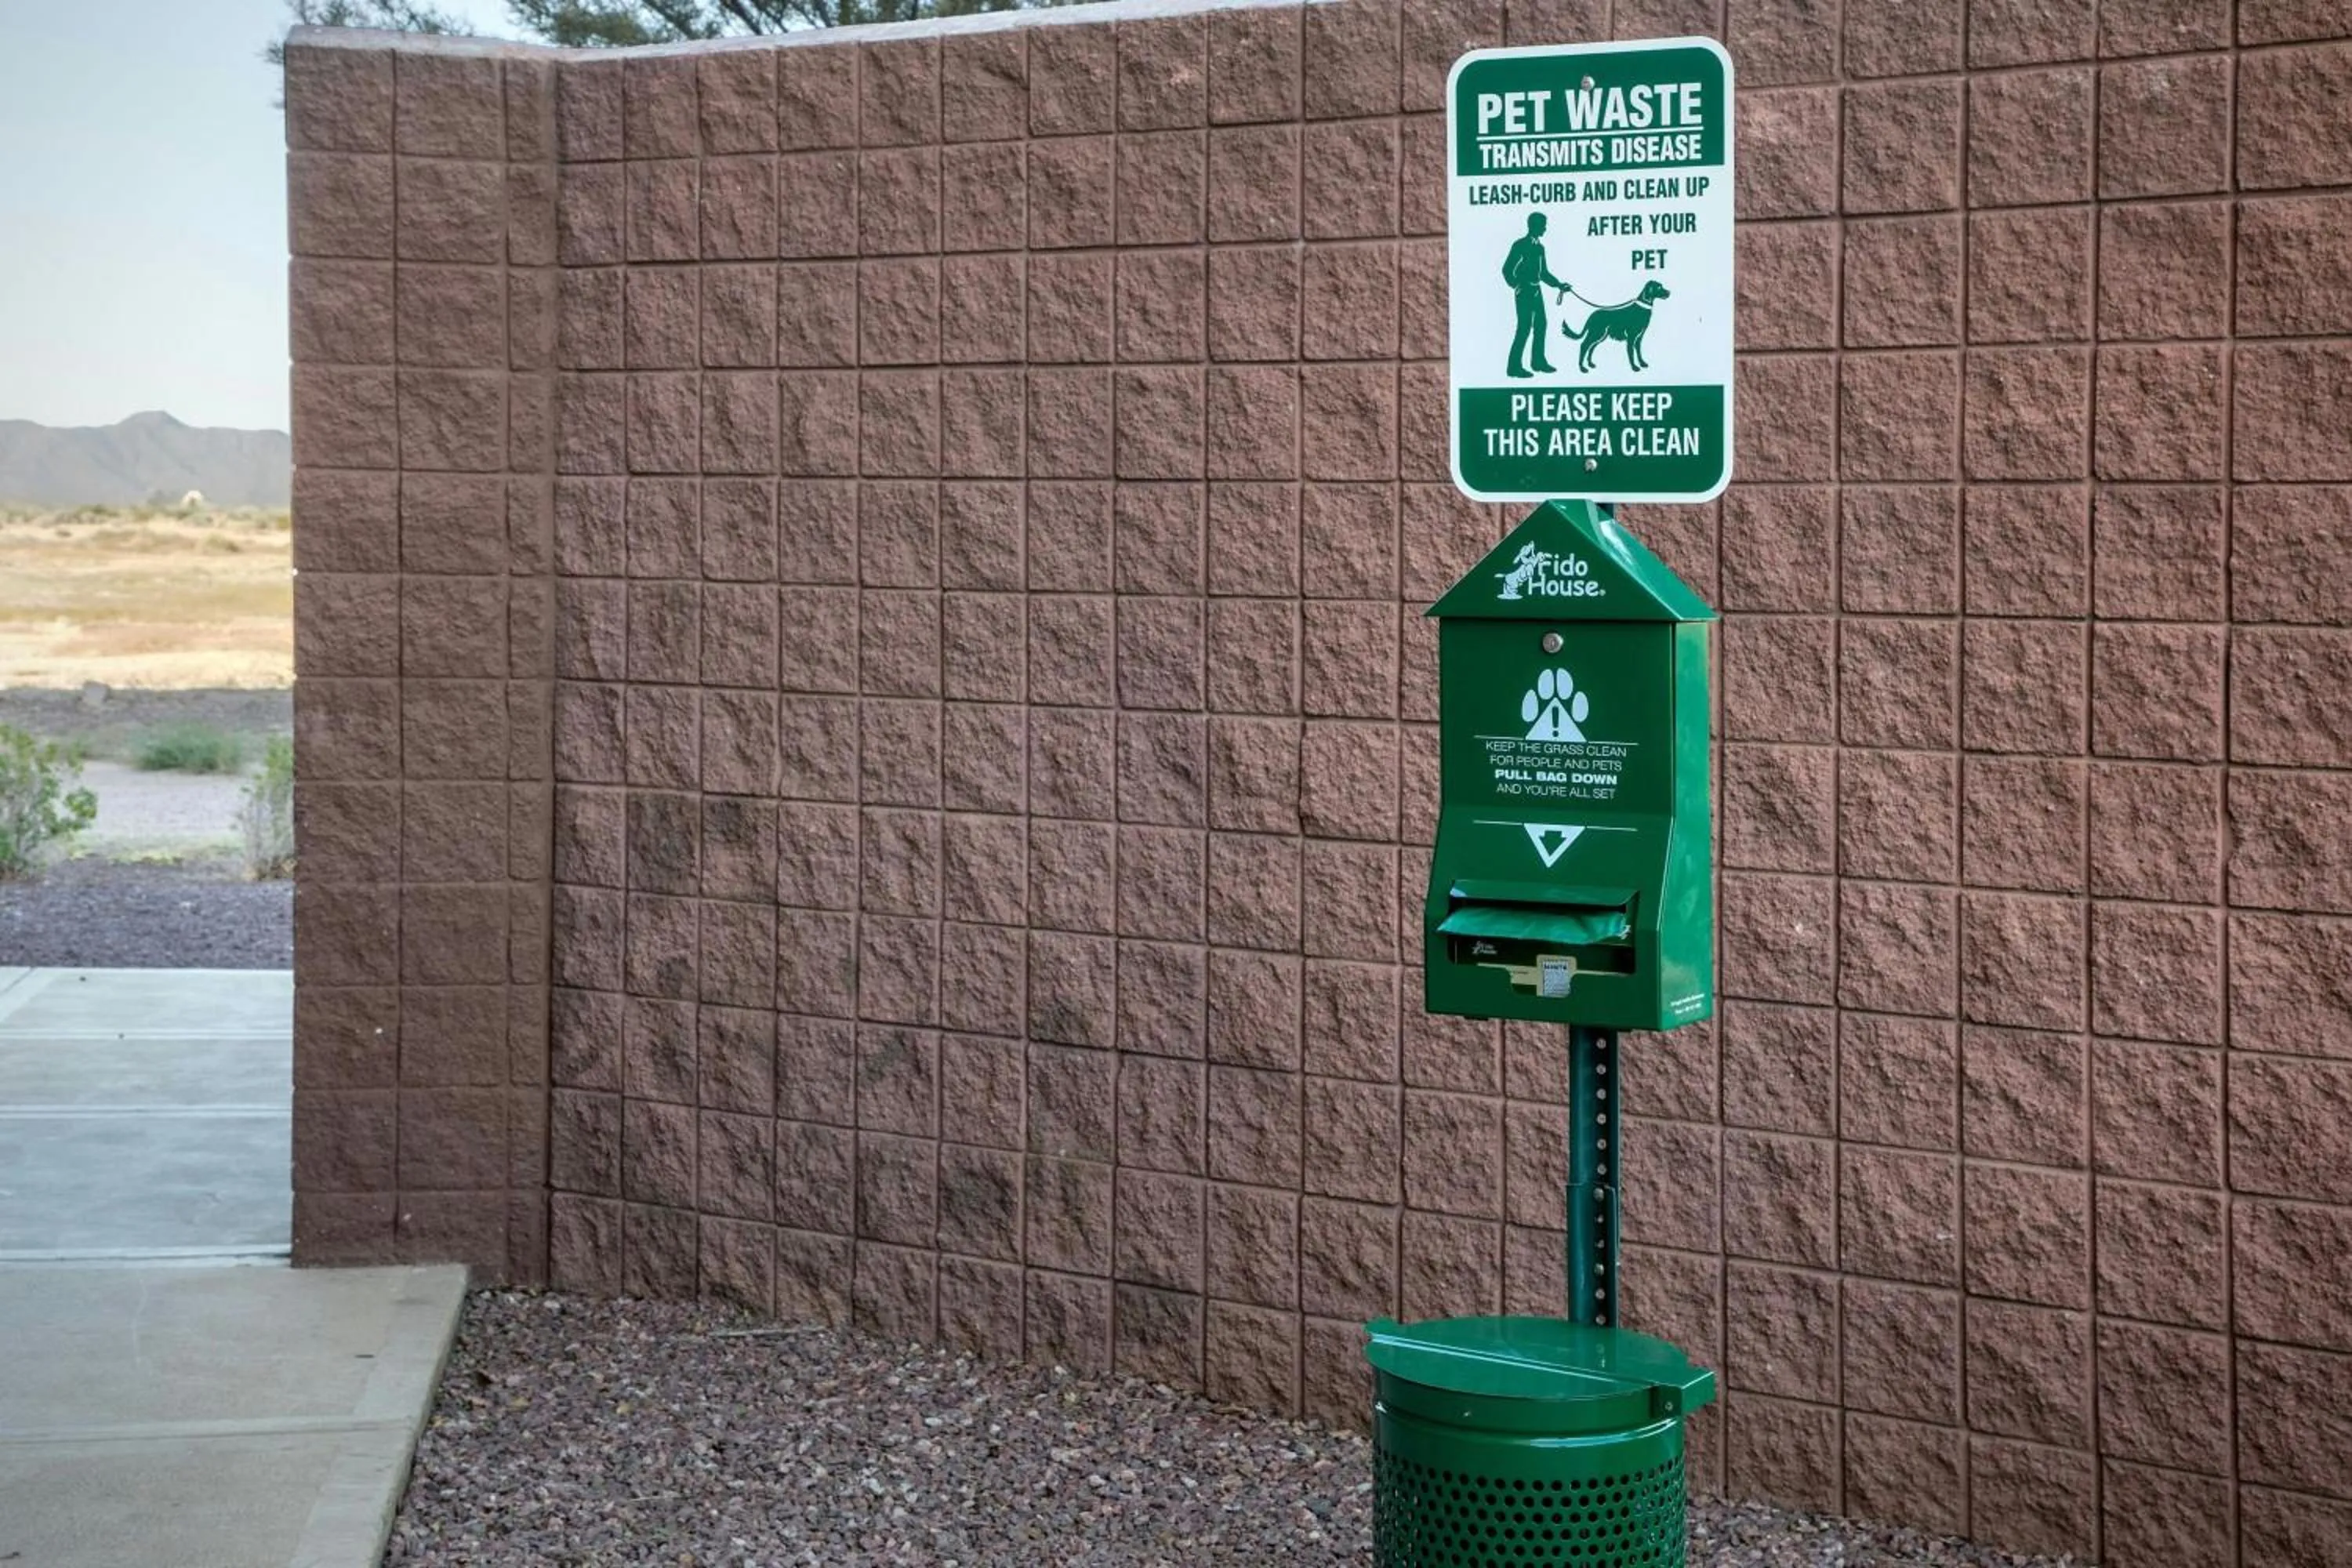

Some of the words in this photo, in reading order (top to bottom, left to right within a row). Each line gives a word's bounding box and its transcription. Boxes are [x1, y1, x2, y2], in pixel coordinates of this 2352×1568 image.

[1477, 90, 1551, 135] PET
[1565, 82, 1702, 129] WASTE
[1479, 140, 1603, 169] TRANSMITS
[1611, 134, 1702, 164] DISEASE
[1468, 183, 1576, 206] LEASH-CURB
[1582, 181, 1617, 201] AND
[1624, 179, 1679, 199] CLEAN
[1686, 176, 1710, 197] UP
[1587, 215, 1642, 236] AFTER
[1649, 212, 1697, 234] YOUR
[1632, 249, 1668, 270] PET
[1511, 394, 1602, 422] PLEASE
[1611, 393, 1672, 420] KEEP
[1483, 429, 1539, 456] THIS
[1548, 428, 1613, 455] AREA
[1621, 427, 1699, 455] CLEAN
[1537, 551, 1588, 576] Fido
[1486, 741, 1515, 751] KEEP
[1519, 742, 1541, 753] THE
[1544, 743, 1584, 755] GRASS
[1586, 746, 1627, 757] CLEAN
[1490, 755, 1514, 766] FOR
[1516, 757, 1561, 768] PEOPLE
[1564, 759, 1589, 770] AND
[1592, 760, 1622, 771] PETS
[1495, 769, 1532, 780] PULL
[1536, 771, 1567, 782] BAG
[1571, 773, 1617, 785] DOWN
[1496, 783, 1522, 794] AND
[1524, 786, 1567, 797] YOU'RE
[1570, 787, 1590, 798] ALL
[1592, 788, 1616, 800] SET
